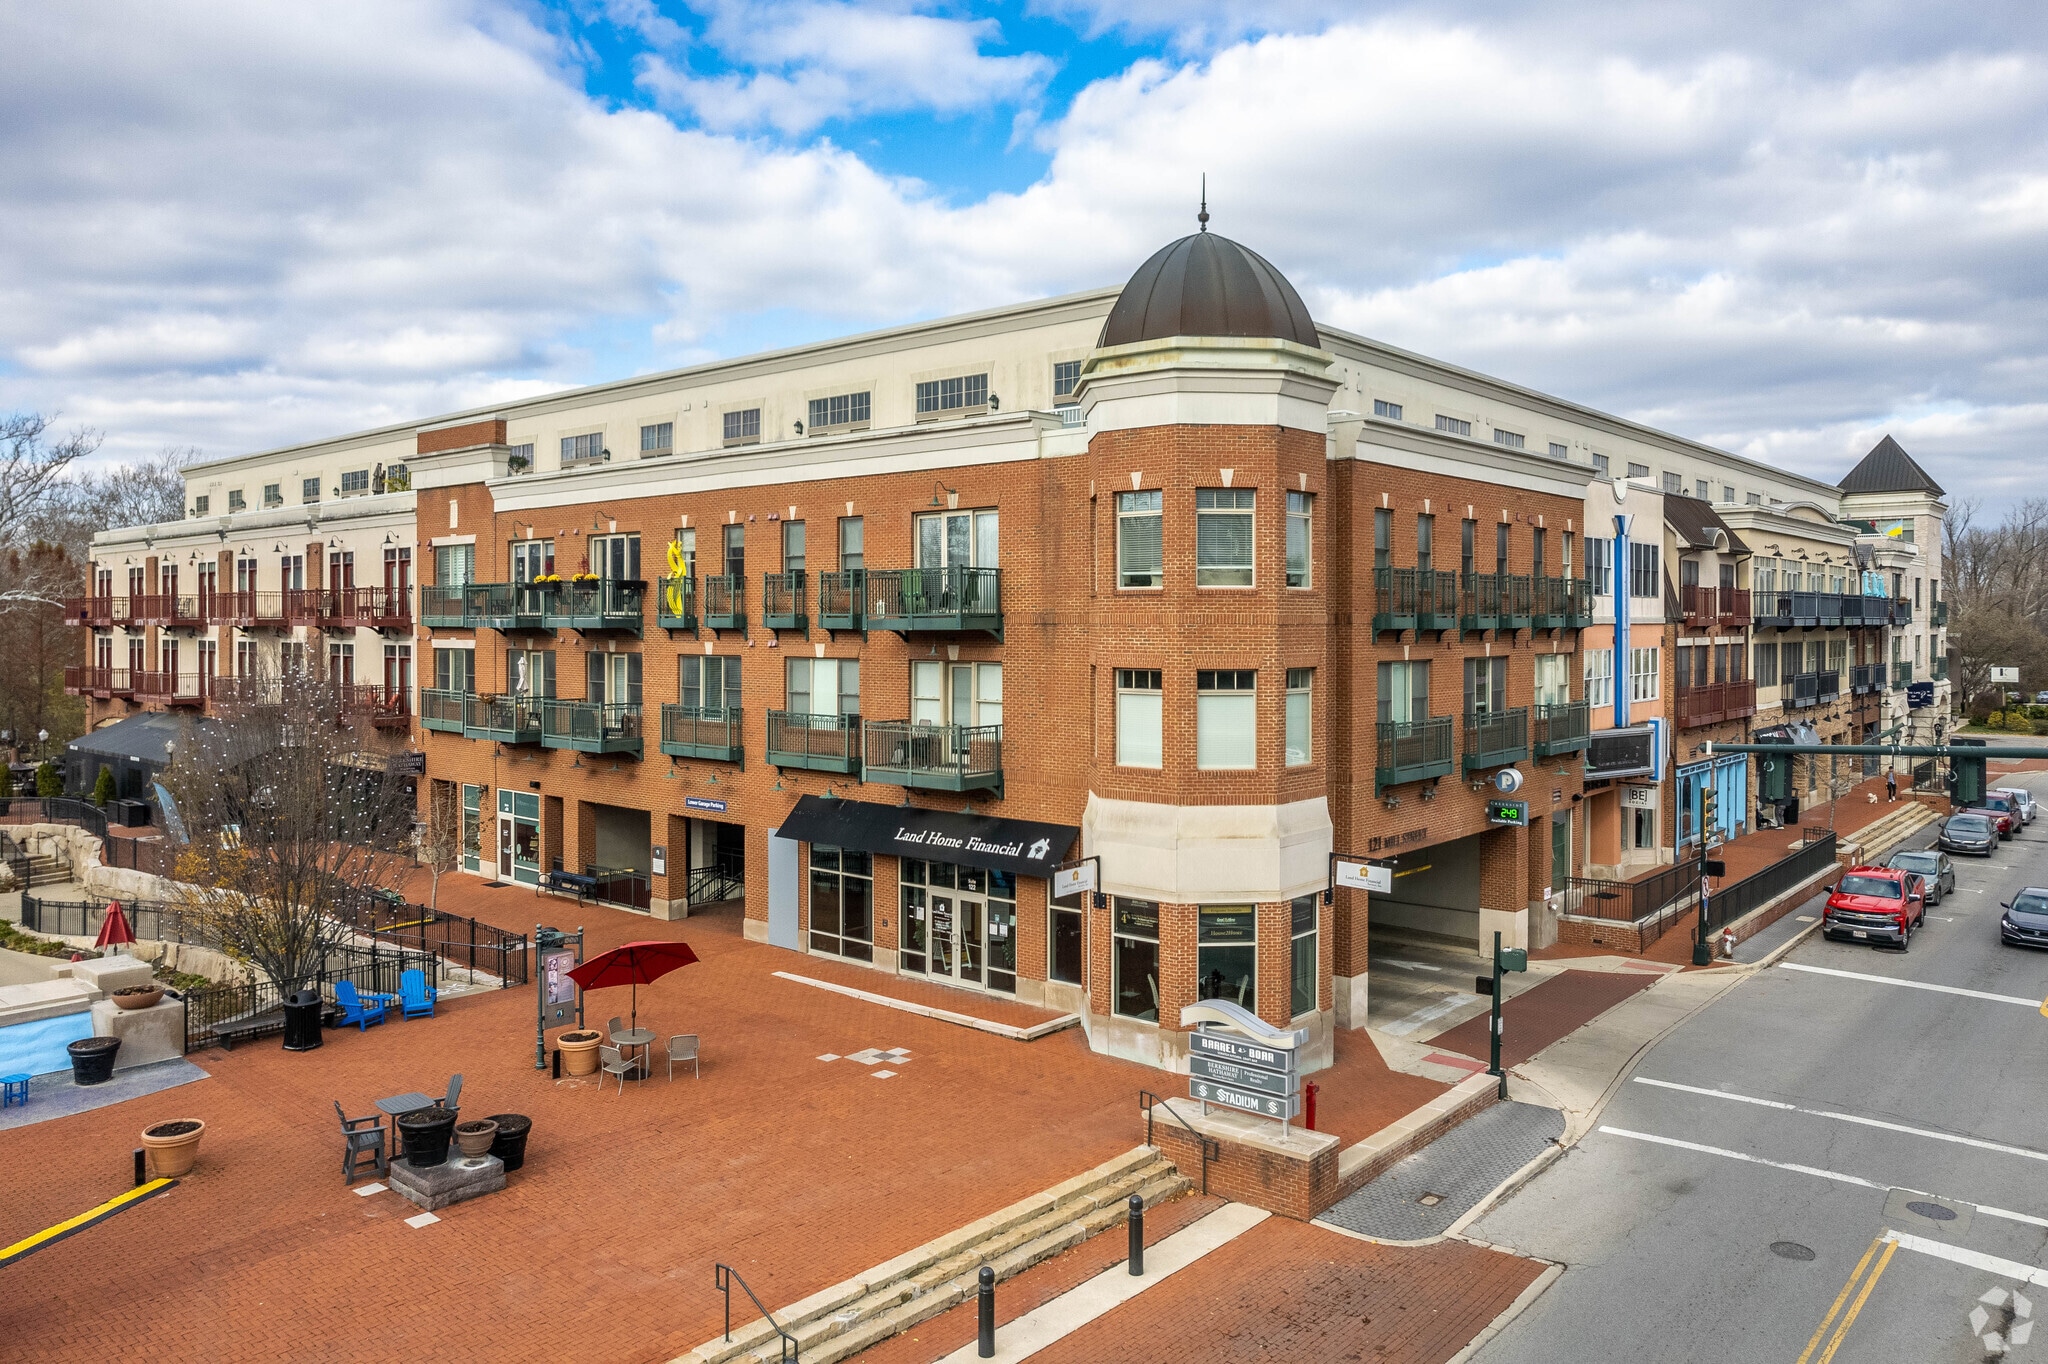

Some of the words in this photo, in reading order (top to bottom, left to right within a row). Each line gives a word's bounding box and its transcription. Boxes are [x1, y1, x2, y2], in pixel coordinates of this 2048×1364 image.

[1502, 774, 1513, 788] P
[710, 801, 724, 810] Parking
[1500, 808, 1517, 819] 249
[894, 827, 928, 843] Land
[926, 832, 963, 848] Home
[965, 837, 1024, 856] Financial
[1368, 836, 1381, 852] 121
[1202, 1038, 1236, 1054] BARREL
[1249, 1049, 1274, 1063] BOAR
[1207, 1062, 1239, 1073] BERKSHIRE
[1208, 1067, 1238, 1078] HATHAWAY
[1244, 1070, 1268, 1080] Professional
[1216, 1089, 1259, 1110] STADIUM
